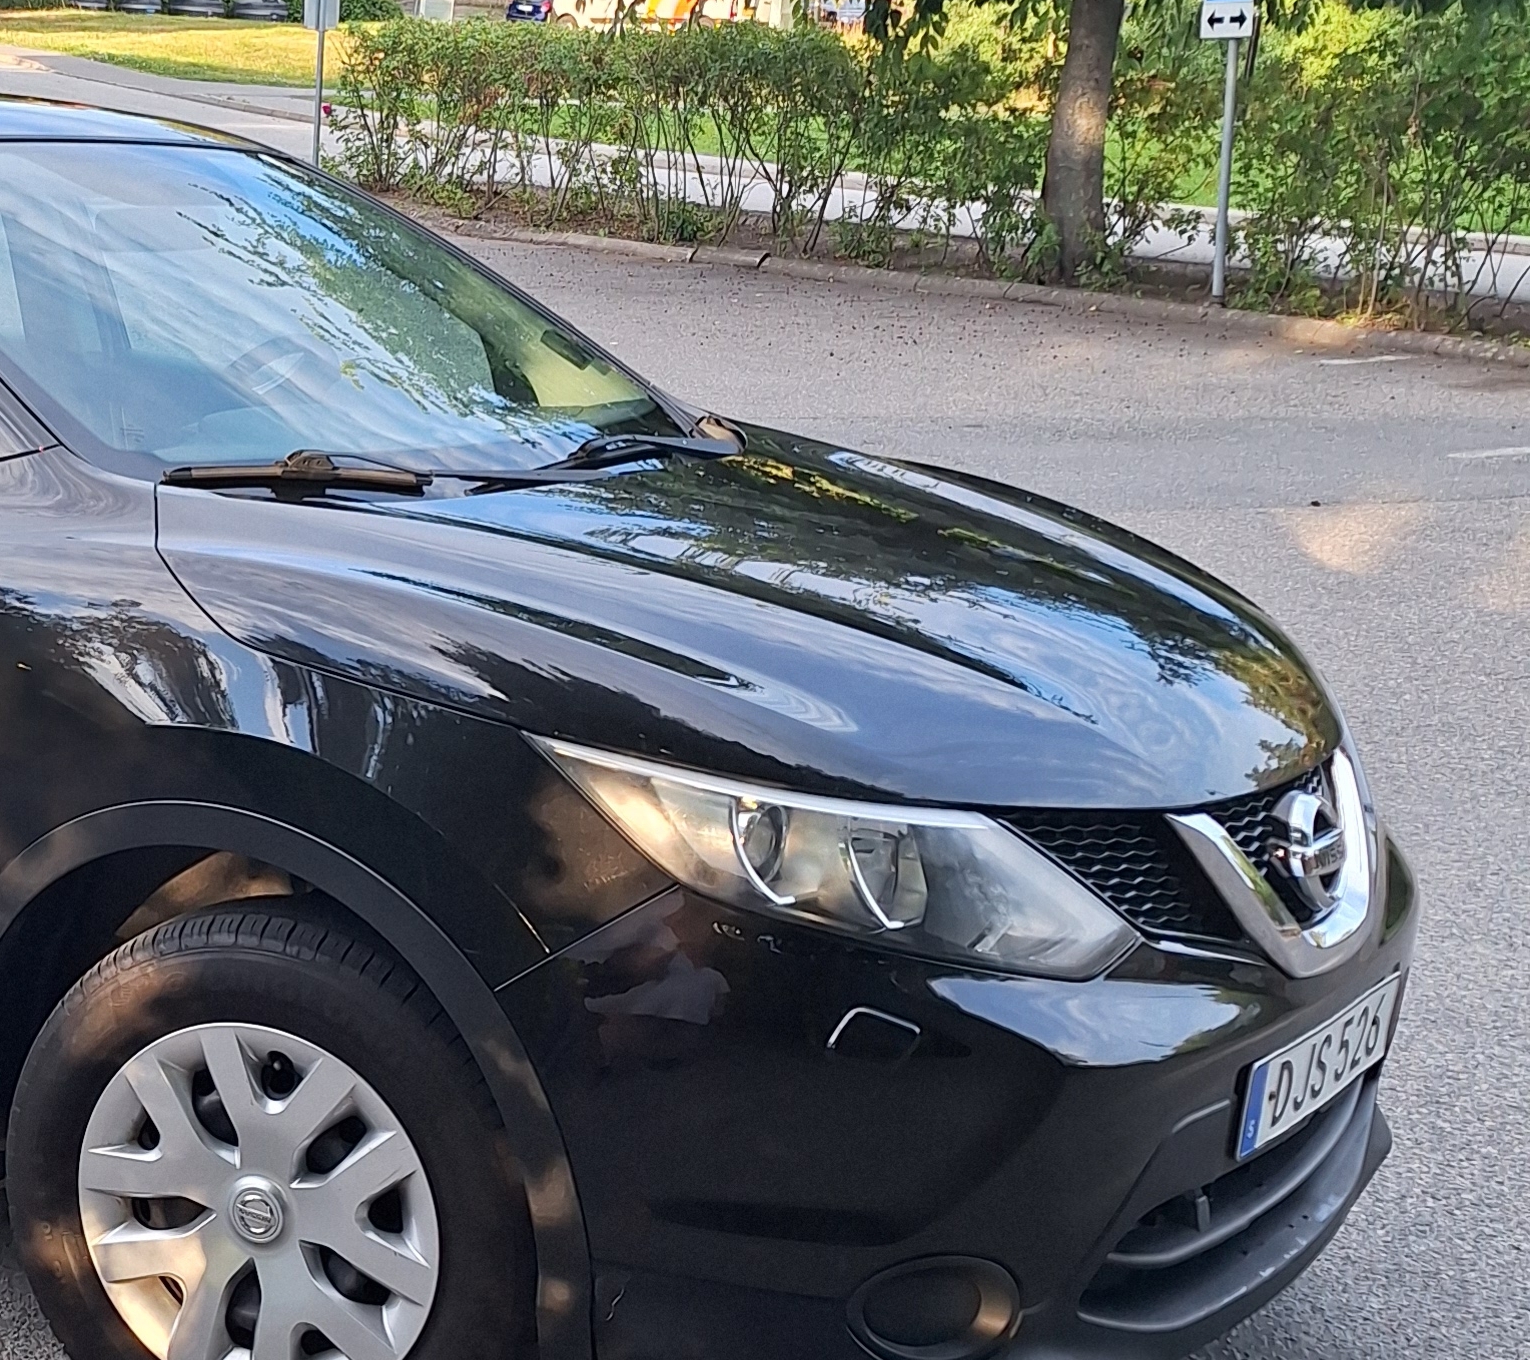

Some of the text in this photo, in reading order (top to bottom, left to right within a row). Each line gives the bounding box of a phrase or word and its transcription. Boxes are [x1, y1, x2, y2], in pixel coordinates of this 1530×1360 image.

[1271, 993, 1386, 1128] DJS 526
[1247, 1119, 1256, 1139] S
